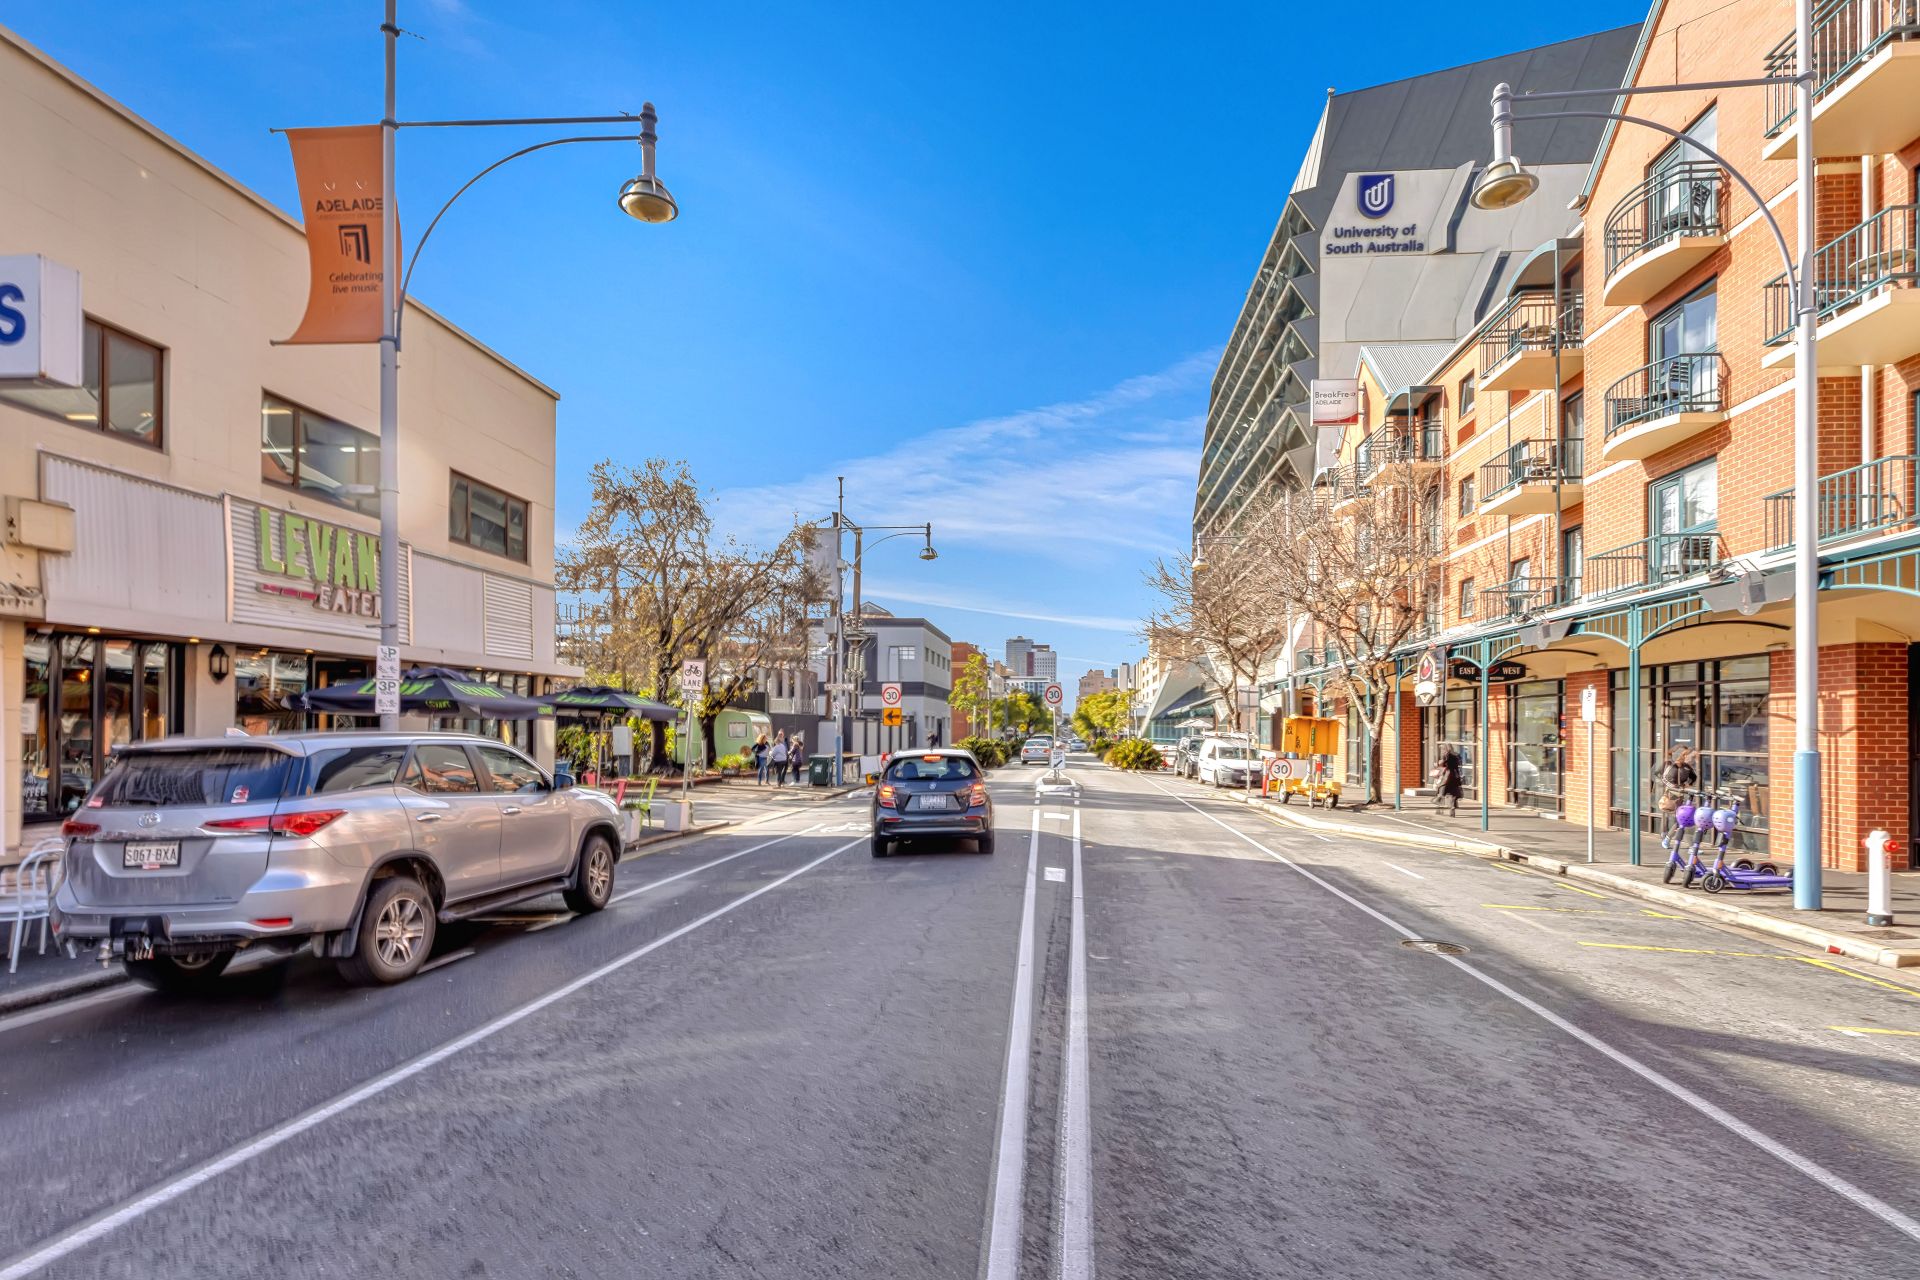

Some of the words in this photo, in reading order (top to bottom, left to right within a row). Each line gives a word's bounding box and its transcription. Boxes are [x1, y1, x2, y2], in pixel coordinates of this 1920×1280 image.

[316, 198, 384, 212] ADELAIDE
[1334, 225, 1399, 239] University
[1402, 224, 1417, 236] of
[1326, 242, 1364, 254] South
[1367, 240, 1425, 254] Australia
[329, 272, 384, 283] Celebrating
[332, 285, 349, 294] live
[351, 284, 379, 293] music
[256, 505, 381, 593] LEVAN
[1459, 666, 1476, 675] EAST
[1502, 666, 1522, 675] WEST
[379, 681, 397, 692] 3P
[683, 679, 702, 687] LANE
[885, 691, 898, 701] 30
[1048, 690, 1060, 700] 30
[1273, 764, 1289, 775] 30
